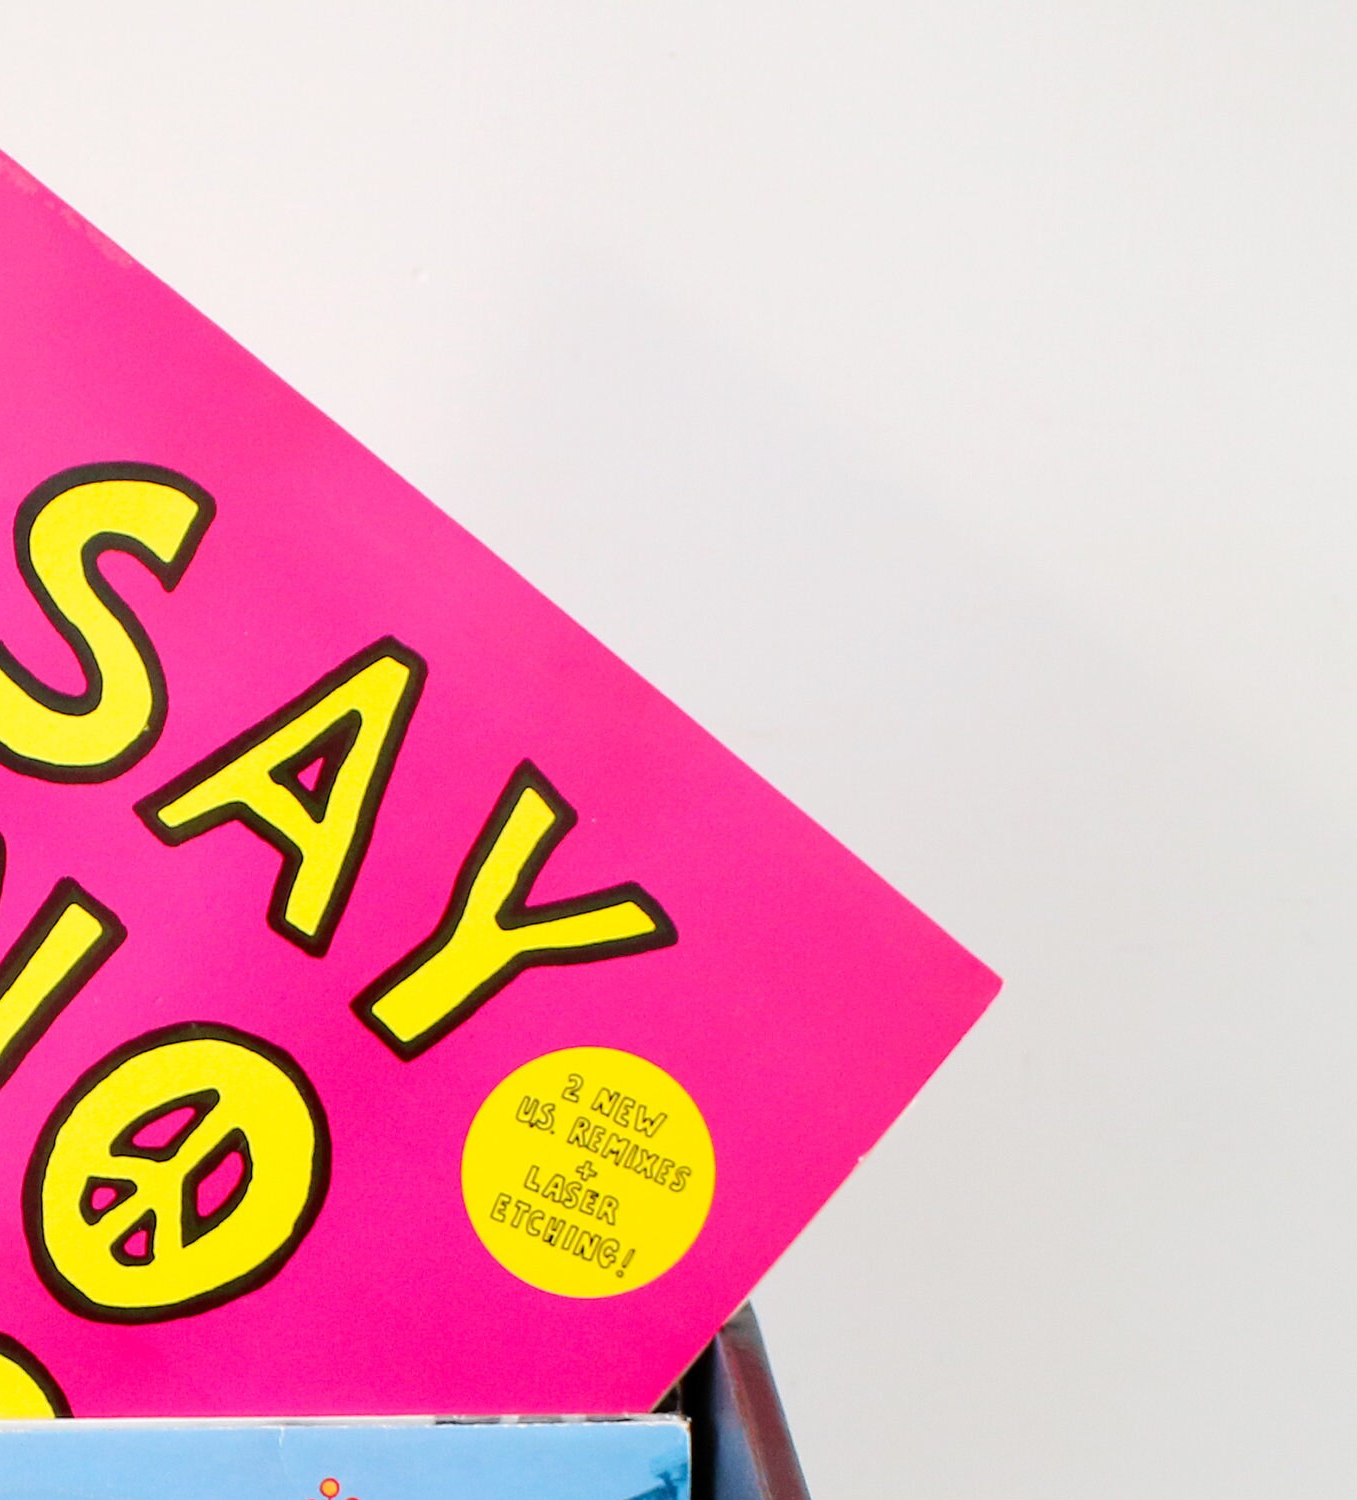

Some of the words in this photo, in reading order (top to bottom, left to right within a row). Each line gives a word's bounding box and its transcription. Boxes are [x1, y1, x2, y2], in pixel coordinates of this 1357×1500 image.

[561, 1073, 584, 1103] 2
[590, 1087, 668, 1138] NEW
[566, 1116, 693, 1193] REMIXES
[523, 1165, 620, 1226] LASER
[489, 1192, 636, 1278] ETCHING!
